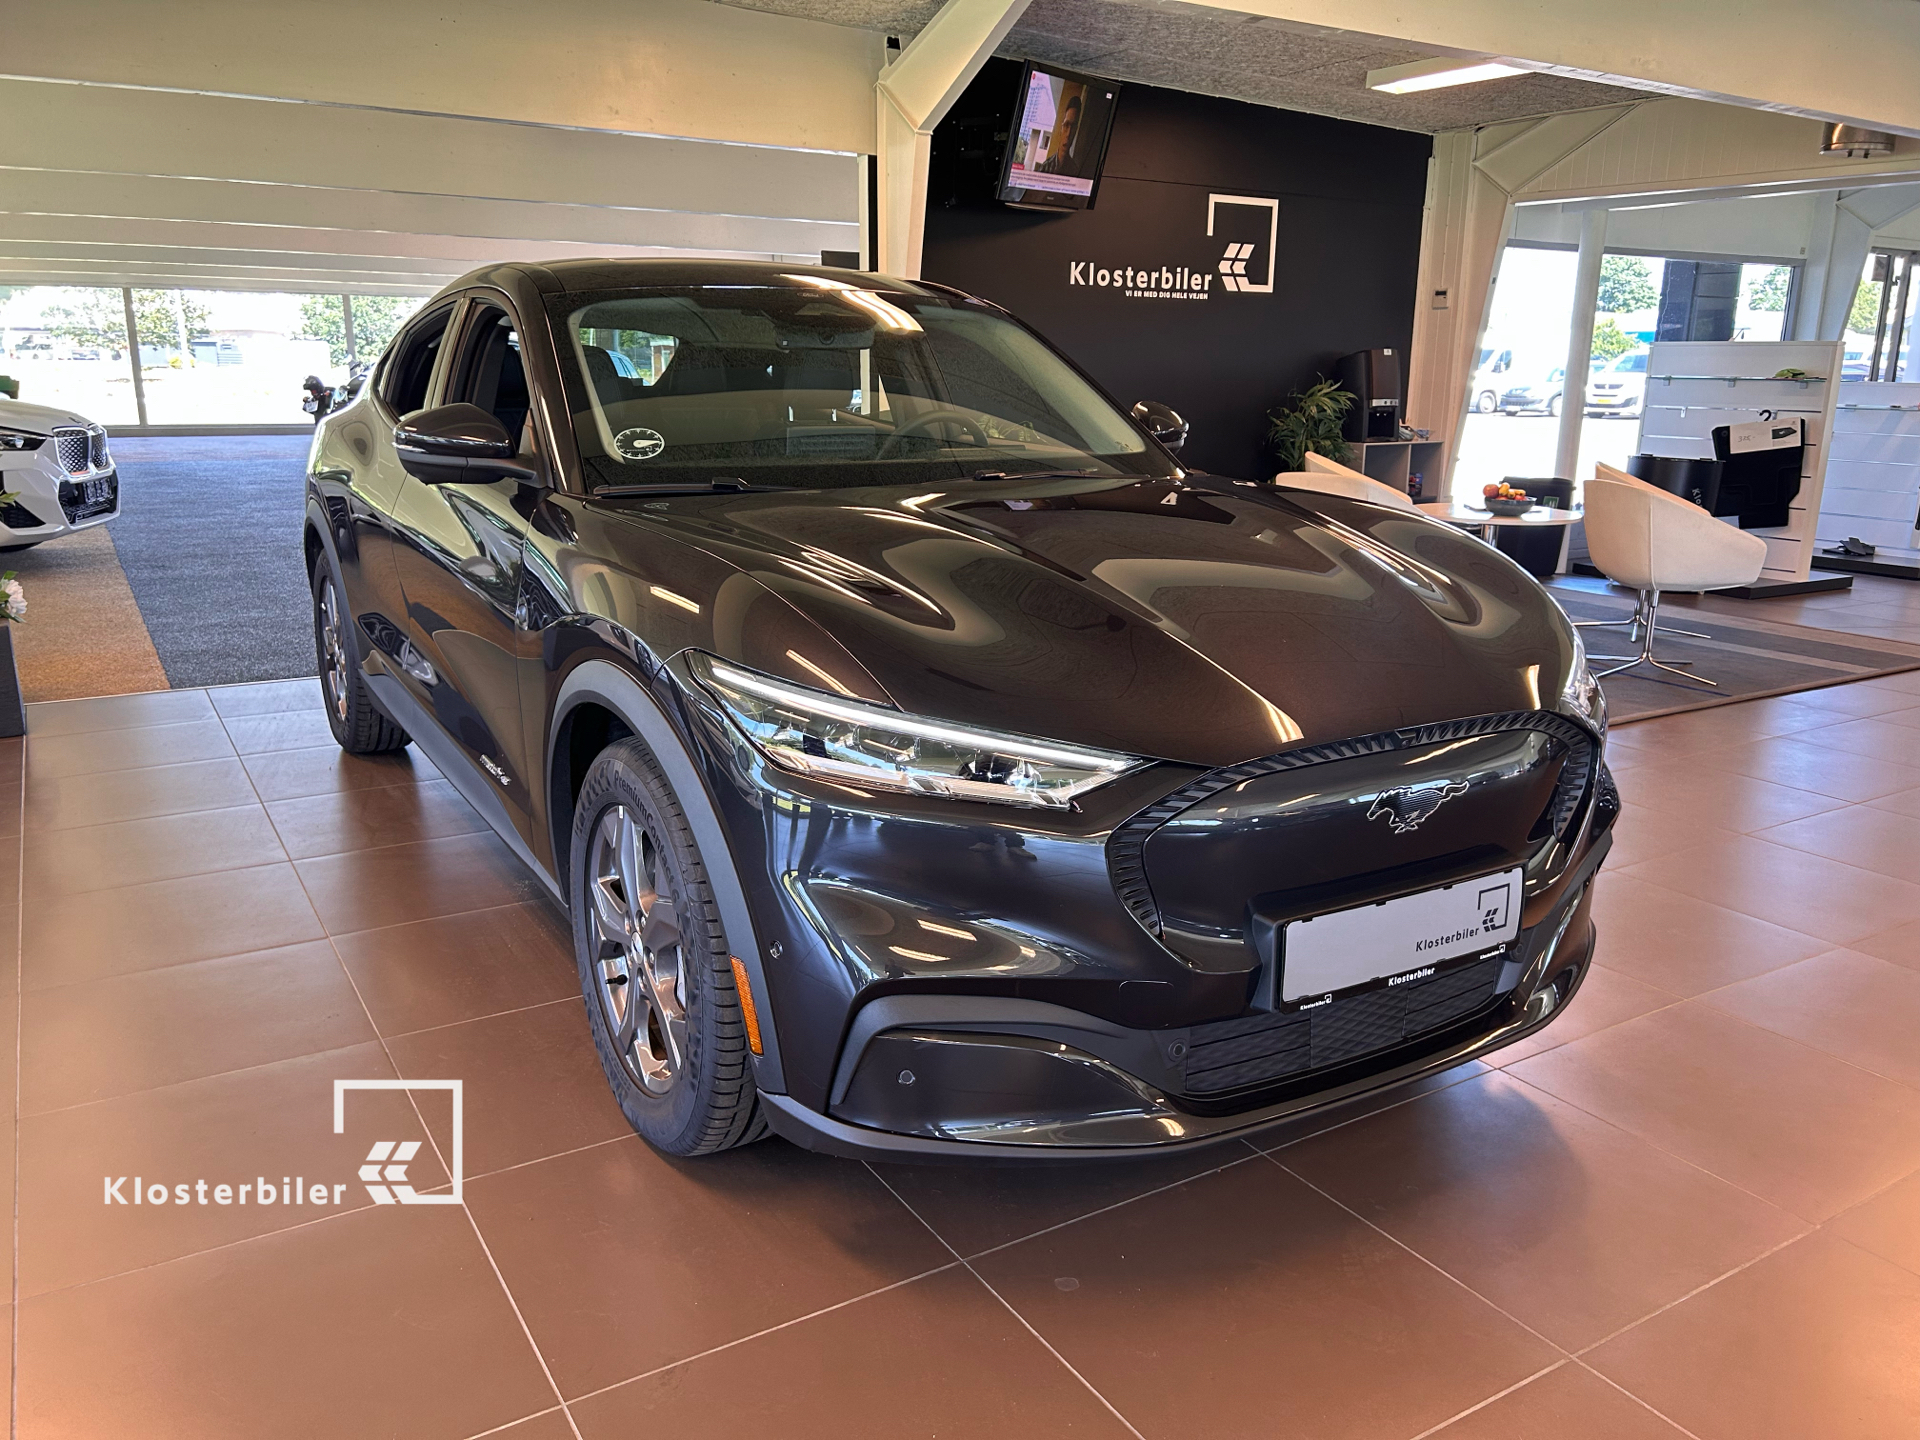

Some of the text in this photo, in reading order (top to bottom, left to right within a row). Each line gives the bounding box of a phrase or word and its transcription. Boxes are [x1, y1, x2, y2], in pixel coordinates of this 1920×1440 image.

[1069, 261, 1213, 291] Klosterbiler
[1133, 290, 1142, 298] ER
[1158, 291, 1171, 299] DIG
[1171, 292, 1188, 300] HELE
[1188, 292, 1209, 300] VEJEN
[1415, 926, 1480, 952] Klosterbiler
[1387, 966, 1436, 987] Klosterbiler
